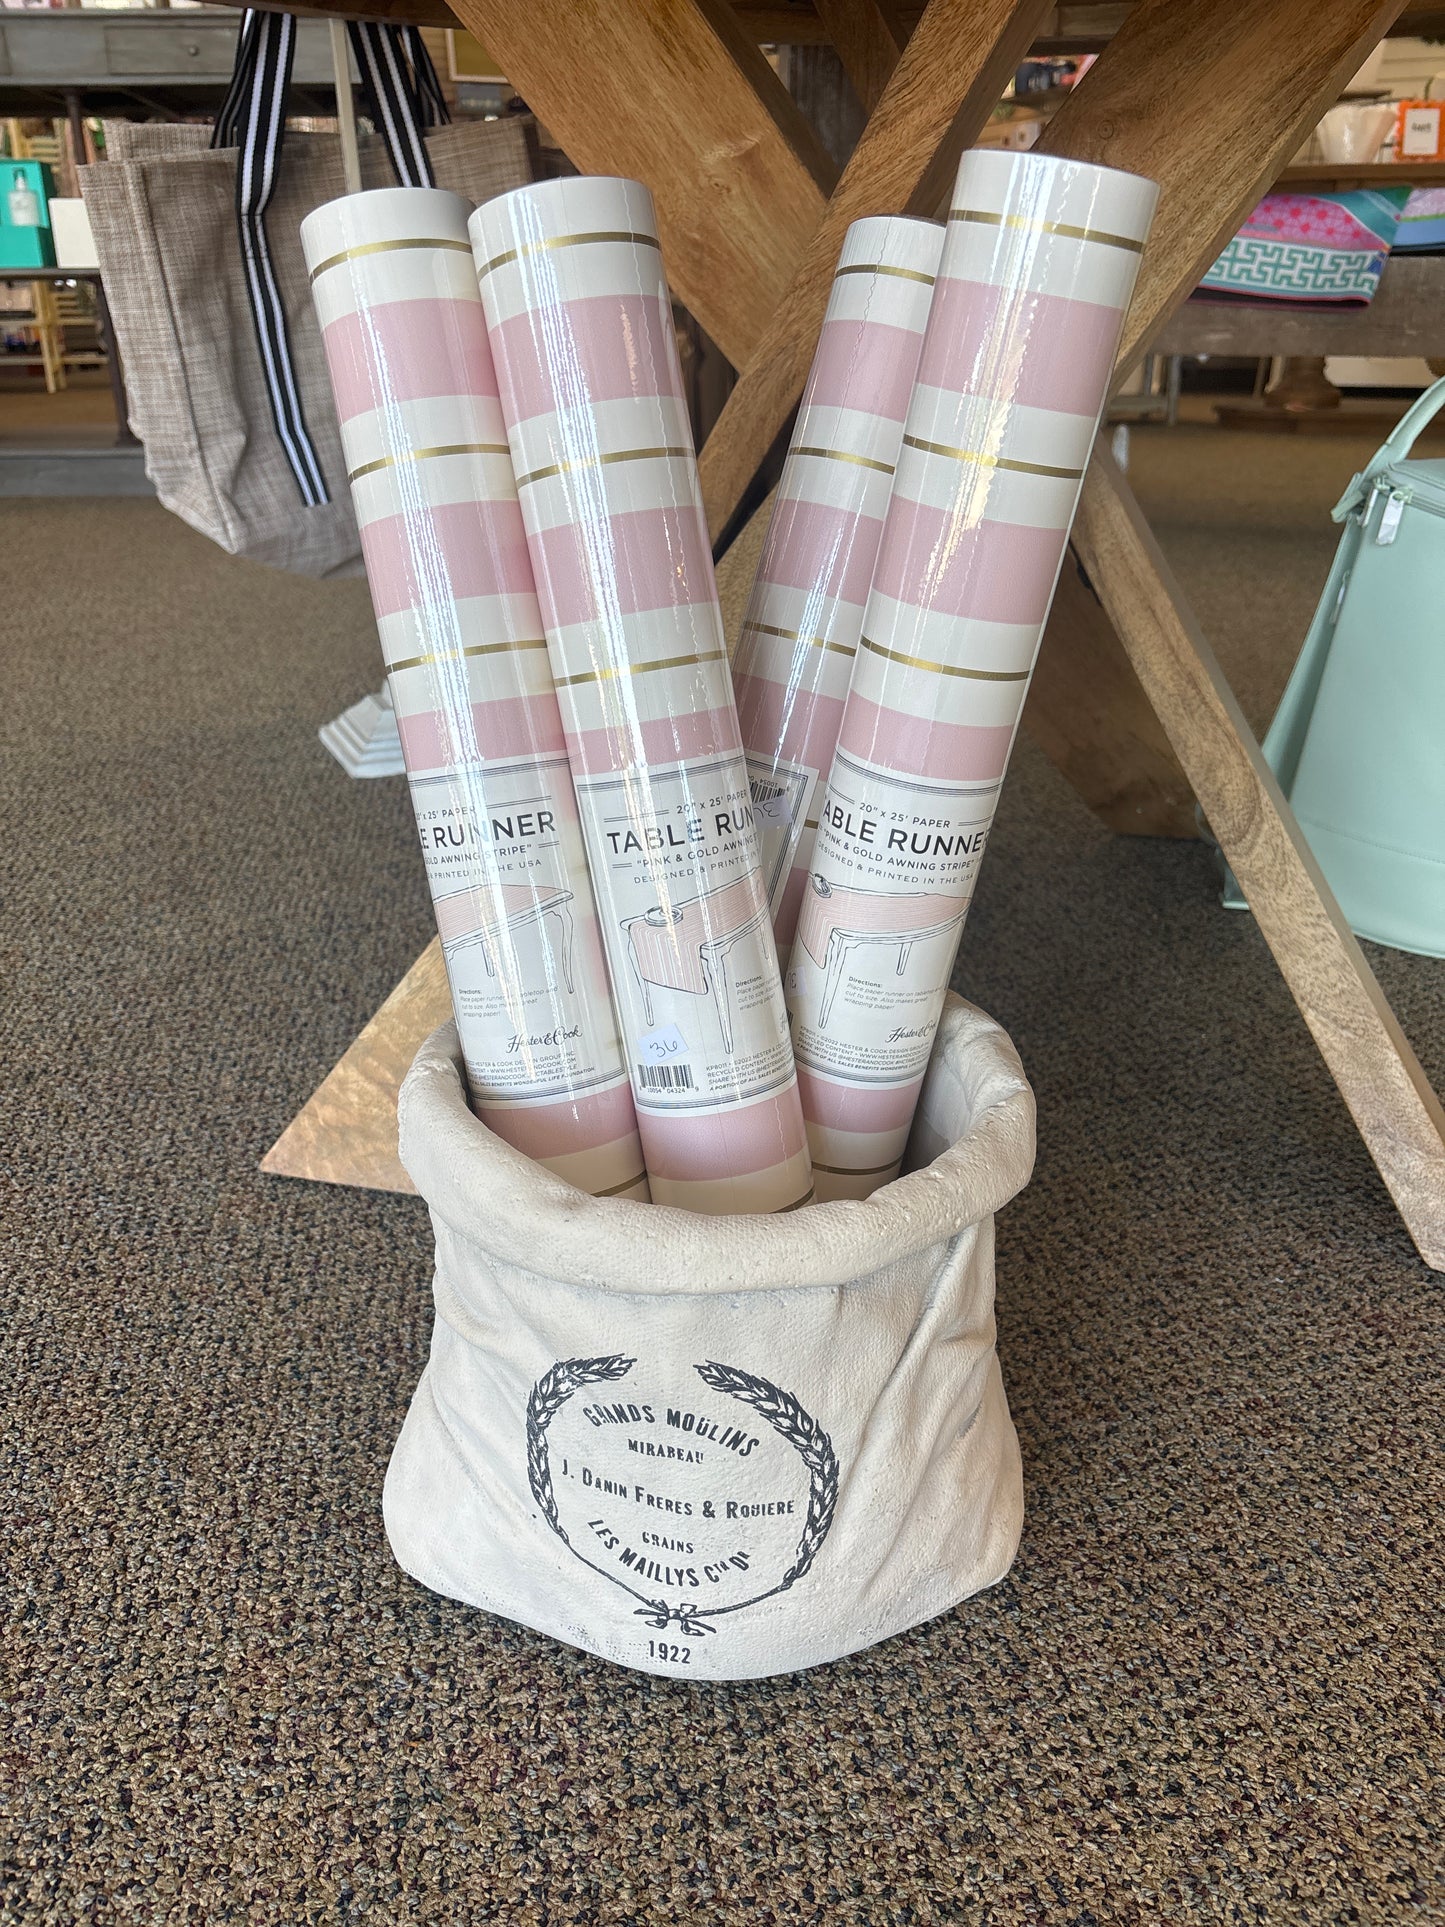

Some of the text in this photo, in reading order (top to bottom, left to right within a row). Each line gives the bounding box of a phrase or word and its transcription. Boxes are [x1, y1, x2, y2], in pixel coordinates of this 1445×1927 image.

[710, 796, 724, 807] 25'
[822, 799, 877, 845] ABLE
[860, 802, 879, 813] 20"
[890, 813, 908, 823] 25'
[912, 816, 951, 829] PAPER
[606, 803, 754, 855] TABLE RUN
[519, 858, 542, 869] USA
[675, 852, 683, 863] &
[687, 845, 720, 860] GOLD
[843, 842, 849, 851] &
[852, 846, 884, 862] GOLD
[887, 855, 936, 872] AWNING
[939, 859, 975, 871] STRIPE"
[856, 863, 864, 872] &
[867, 866, 919, 884] PRINTED
[923, 876, 935, 885] IN
[939, 876, 958, 885] THE
[649, 1039, 678, 1058] 36
[582, 1403, 656, 1428] GRANDS
[627, 1438, 704, 1465] MIRABEAU
[562, 1458, 575, 1479] J.
[634, 1485, 693, 1516] FRERES
[702, 1500, 716, 1519] &
[587, 1519, 620, 1550] LES
[618, 1547, 700, 1587] MAILLYS
[641, 1531, 695, 1554] GRAINS
[648, 1640, 692, 1665] 1922
